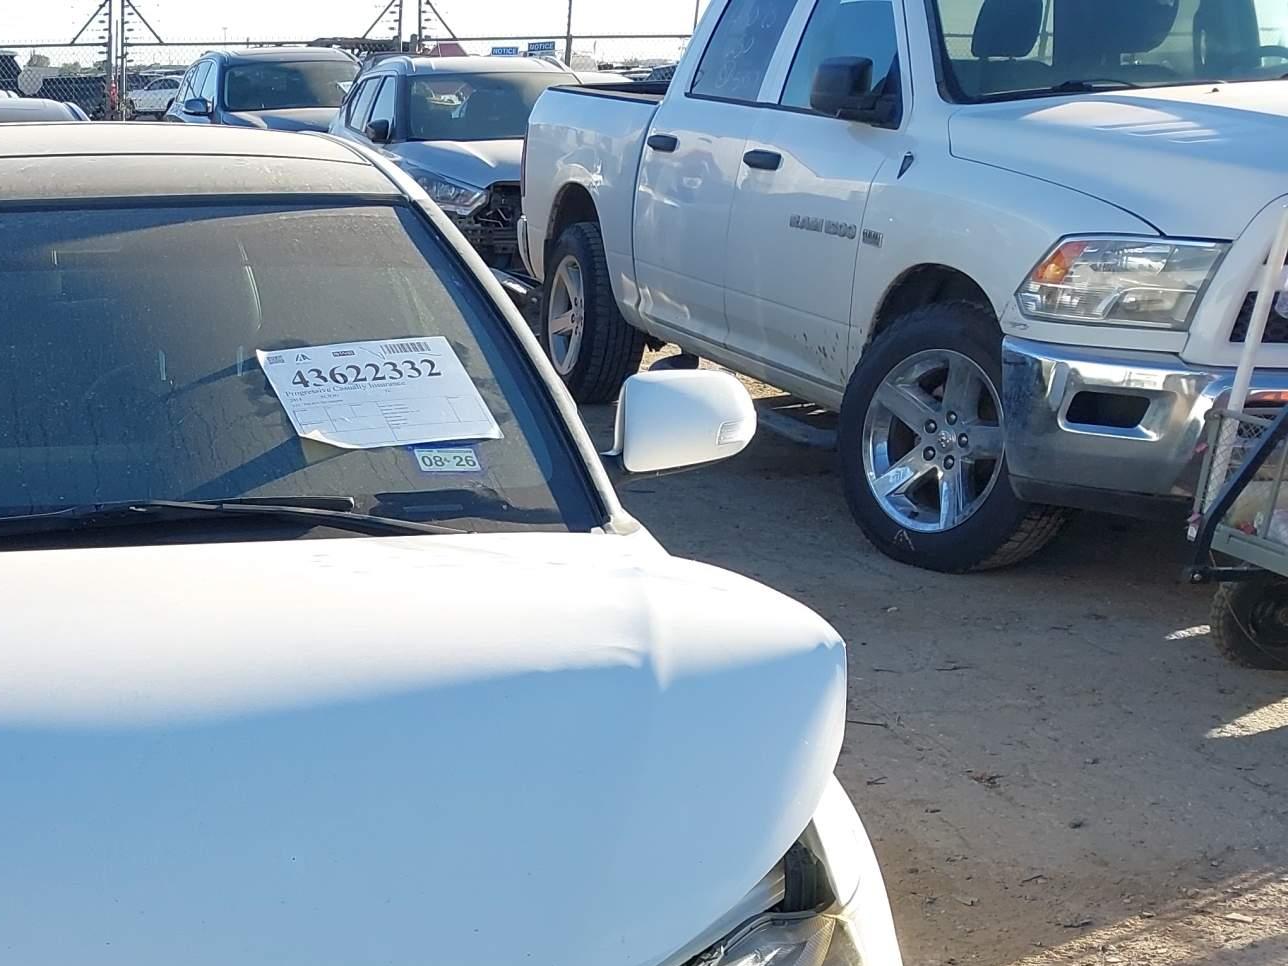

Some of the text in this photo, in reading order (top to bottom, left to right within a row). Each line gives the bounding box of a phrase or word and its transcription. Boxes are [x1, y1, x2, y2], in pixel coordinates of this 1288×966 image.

[492, 47, 517, 55] NOTICE
[292, 359, 441, 387] 43622332
[285, 380, 406, 397] Progressive Casualty Insurance
